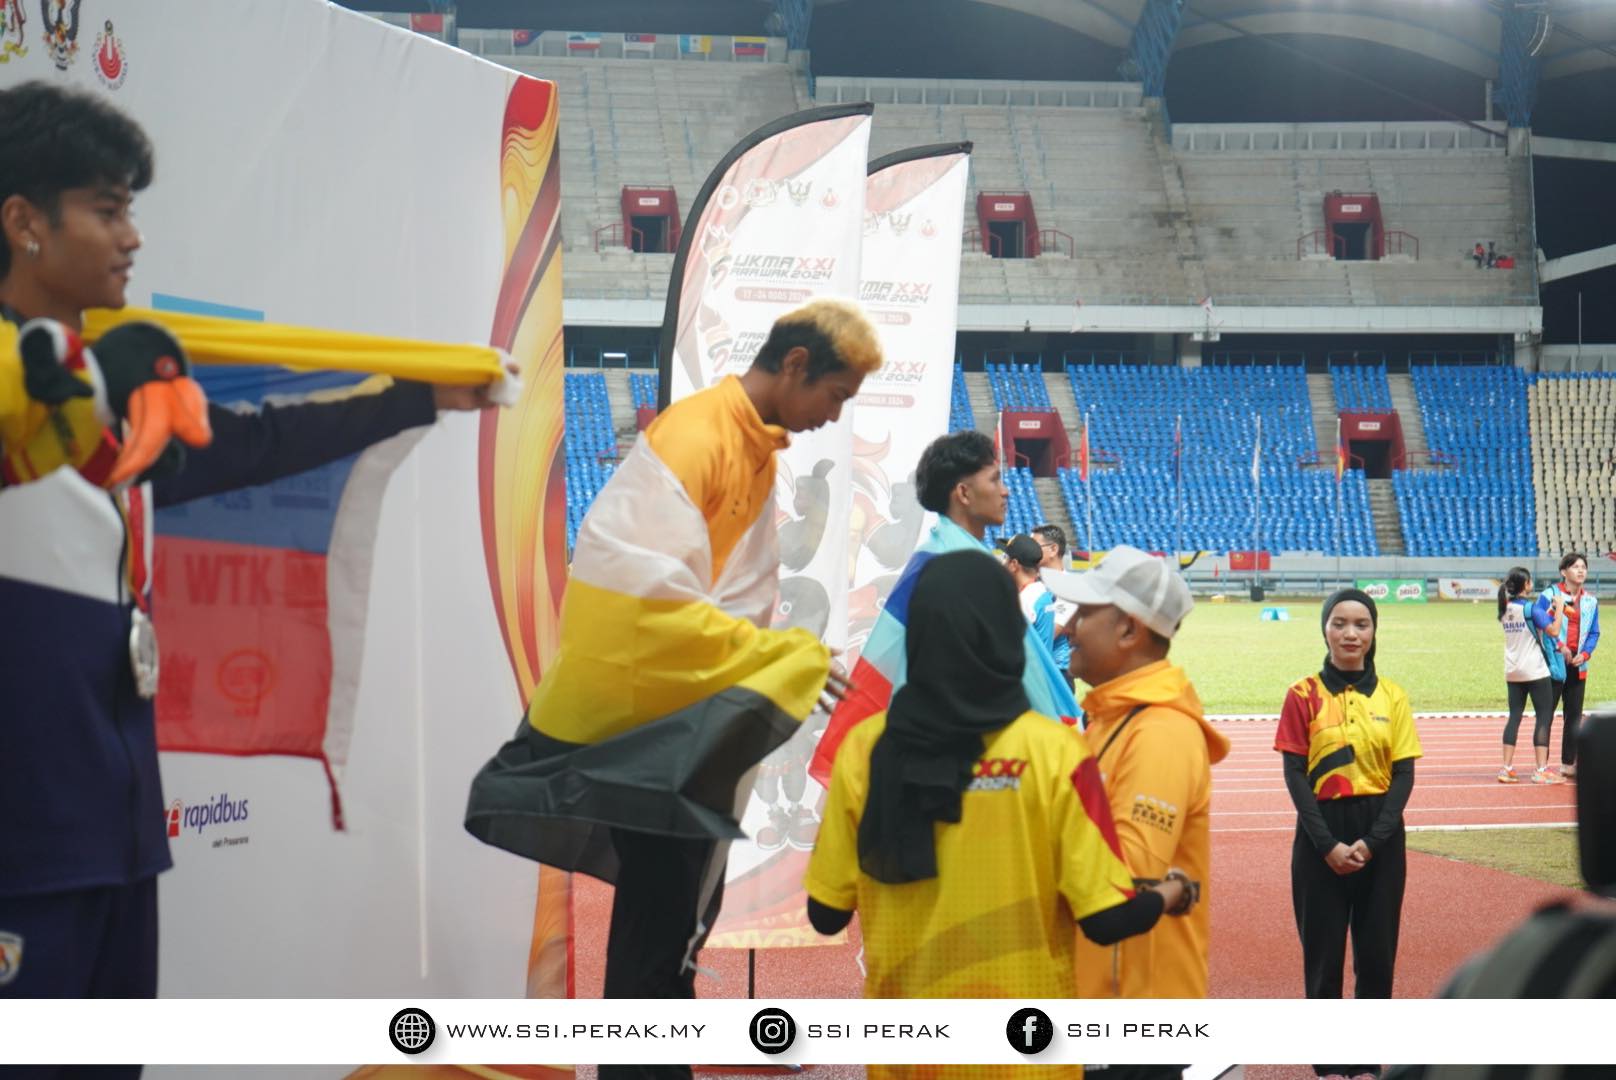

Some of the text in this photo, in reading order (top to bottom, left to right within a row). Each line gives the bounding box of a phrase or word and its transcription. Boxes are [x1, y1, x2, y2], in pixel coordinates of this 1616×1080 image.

[796, 256, 836, 269] XXI
[790, 270, 833, 281] 2024
[896, 282, 932, 295] XXI
[889, 294, 929, 304] 2024
[886, 373, 924, 383] 2024
[184, 553, 273, 606] WTK
[973, 759, 1029, 779] XXI
[183, 793, 249, 834] rapidbus
